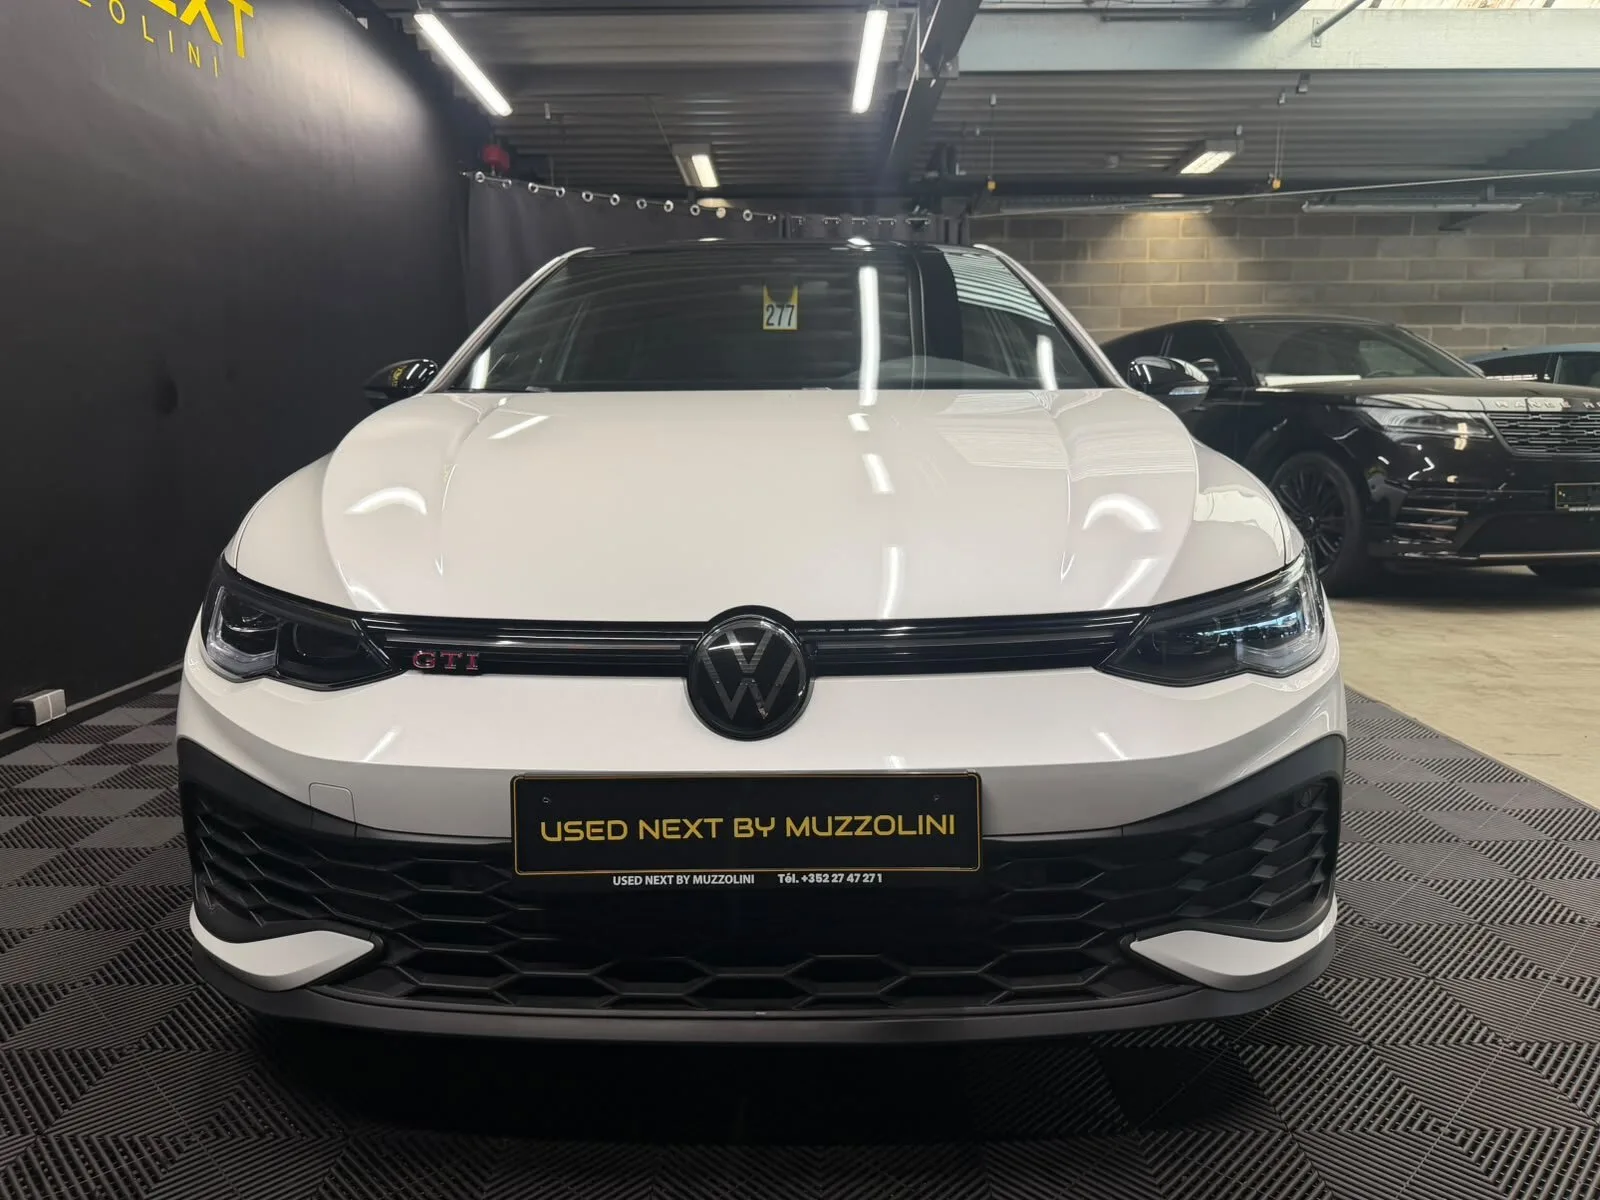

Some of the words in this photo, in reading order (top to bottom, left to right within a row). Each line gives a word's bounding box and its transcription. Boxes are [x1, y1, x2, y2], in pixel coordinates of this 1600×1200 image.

[766, 304, 795, 327] 277
[412, 650, 480, 671] GTI
[540, 819, 629, 842] USED
[638, 817, 724, 840] NEXT
[733, 816, 776, 838] BY
[785, 814, 955, 837] MUZZOLINI
[612, 875, 643, 886] USED
[645, 875, 675, 886] NEXT
[676, 875, 690, 885] BY
[692, 874, 755, 885] MUZZOLINI
[777, 872, 800, 884] Tél.
[800, 873, 830, 884] +352
[831, 873, 845, 883] 27
[846, 873, 861, 883] 47
